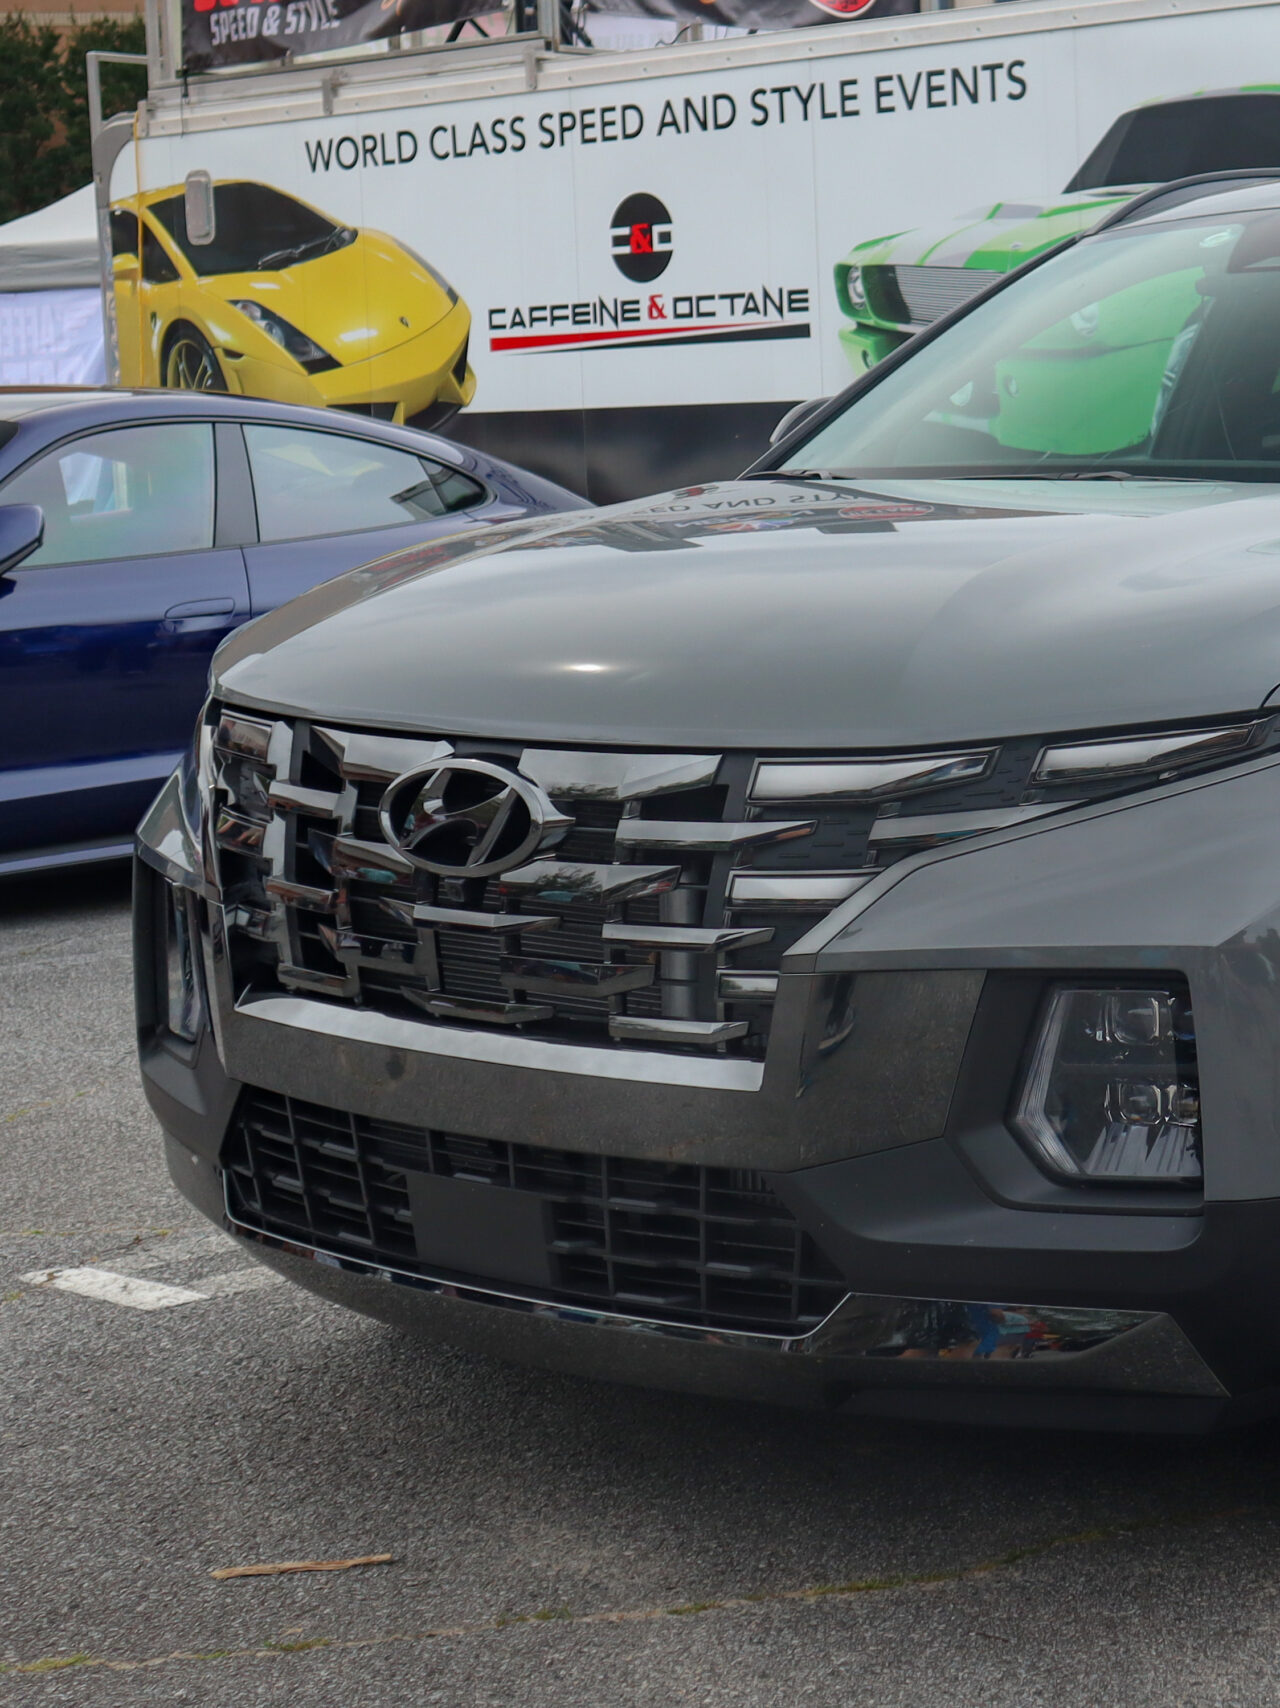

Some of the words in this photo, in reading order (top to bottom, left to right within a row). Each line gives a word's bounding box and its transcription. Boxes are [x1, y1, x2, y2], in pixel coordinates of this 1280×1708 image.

[210, 5, 261, 46] SPEED
[262, 5, 281, 37] &
[284, 0, 341, 35] STYLE
[305, 130, 418, 173] WORLD
[429, 116, 526, 161] CLASS
[538, 103, 644, 150] SPEED
[656, 93, 737, 137] AND
[750, 78, 860, 127] STYLE
[875, 59, 1027, 114] EVENTS
[488, 296, 641, 331] CAFFEINE
[648, 294, 667, 320] &
[672, 286, 810, 320] OCTANE
